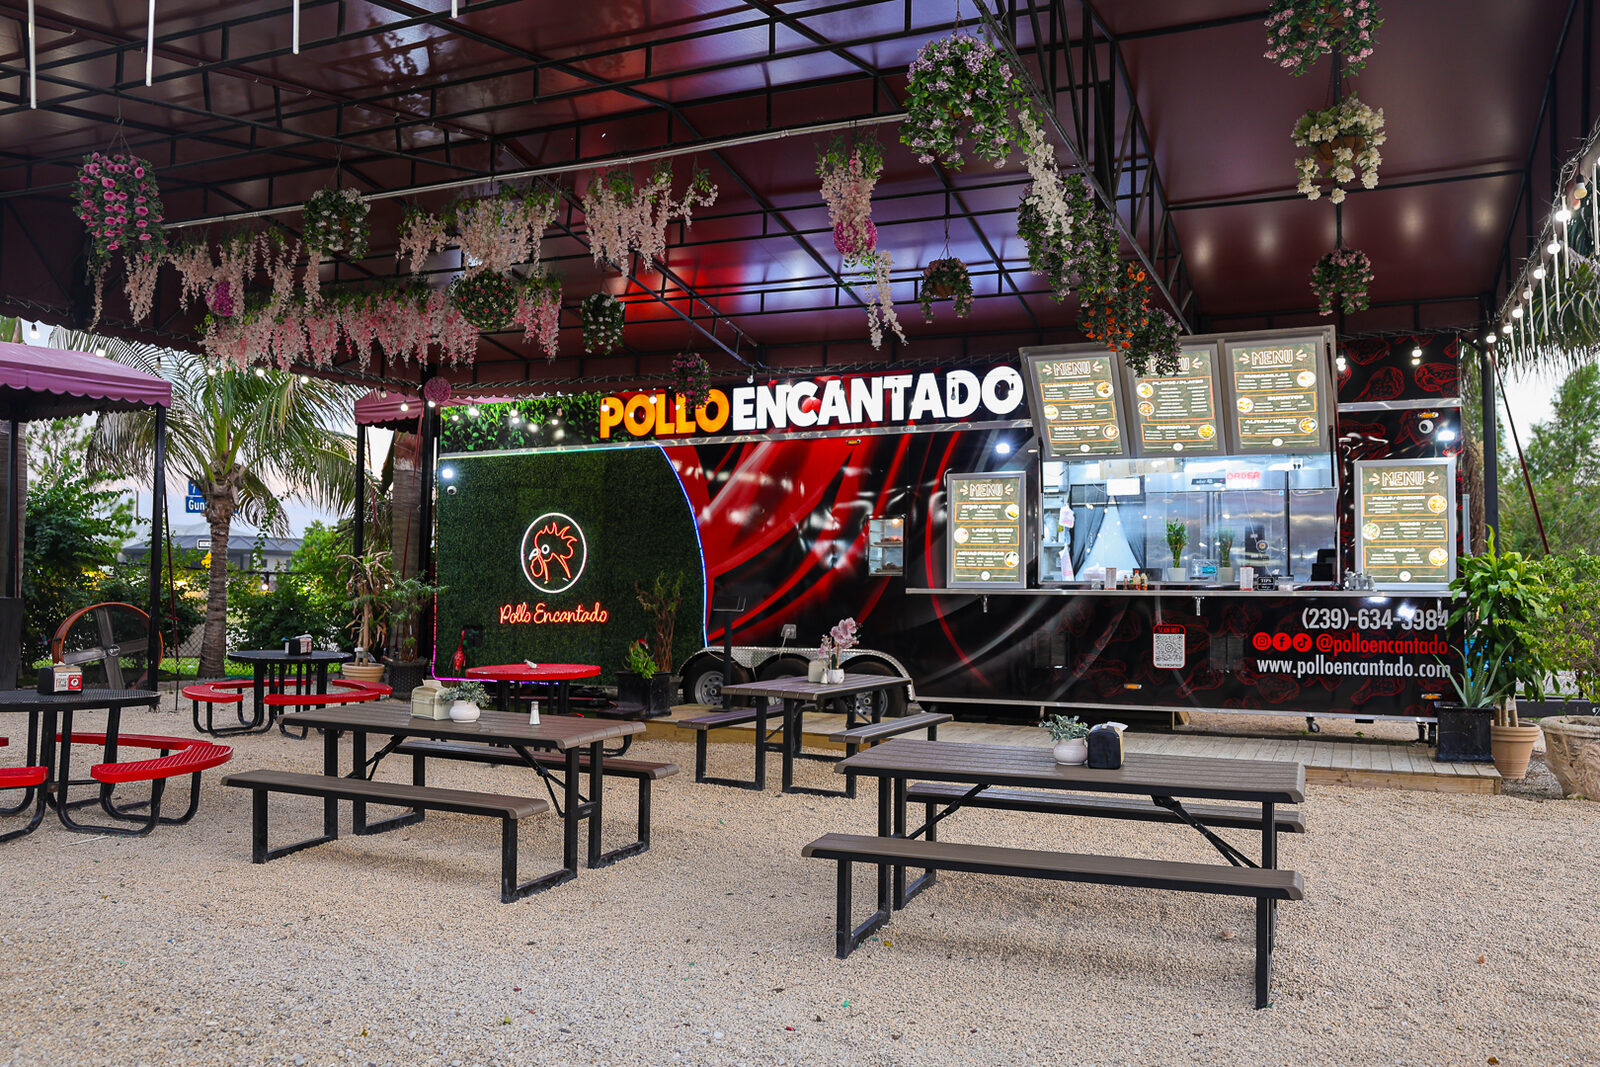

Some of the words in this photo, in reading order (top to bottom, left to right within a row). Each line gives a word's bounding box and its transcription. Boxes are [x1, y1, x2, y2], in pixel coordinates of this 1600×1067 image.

[1251, 349, 1293, 365] MENU
[1053, 361, 1091, 376] MENU
[599, 387, 730, 439] POLLO
[732, 366, 1024, 432] ENCANTADO
[1226, 472, 1261, 480] ORDER
[1381, 470, 1425, 487] MENU
[969, 483, 1004, 497] MENU
[500, 601, 531, 624] Pollo
[533, 601, 609, 624] Encantado
[1315, 632, 1448, 657] @polloencantado
[1257, 654, 1450, 678] www.polloencantado.com
